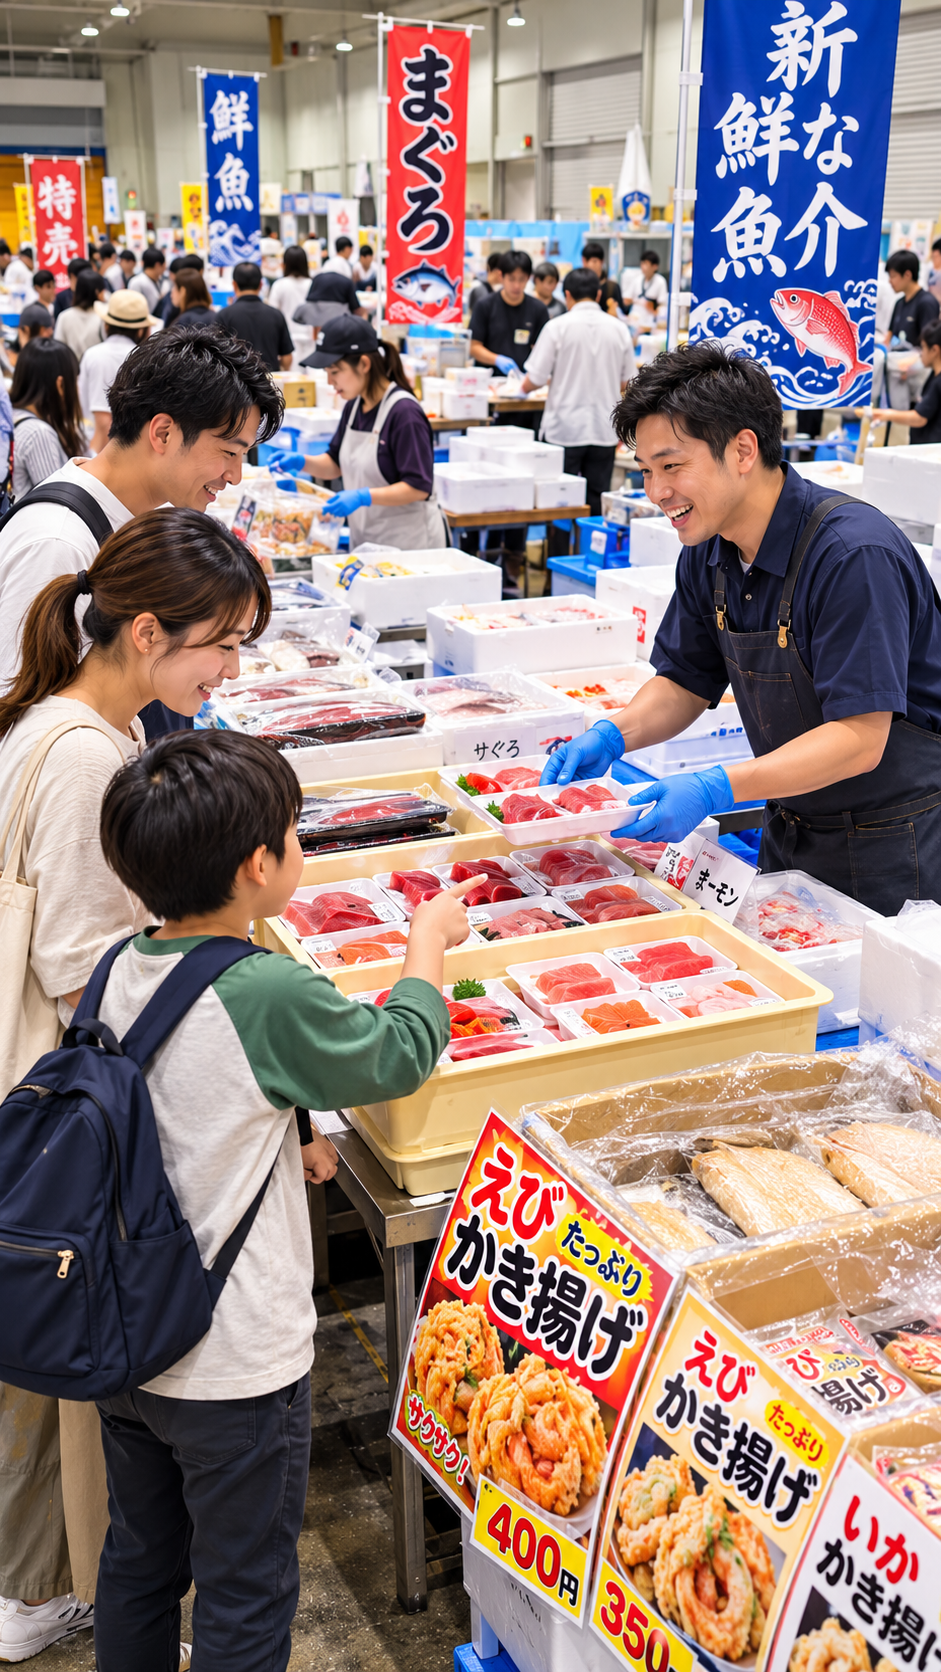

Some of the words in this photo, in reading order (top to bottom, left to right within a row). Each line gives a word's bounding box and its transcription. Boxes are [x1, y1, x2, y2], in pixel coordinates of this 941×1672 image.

[209, 90, 254, 213] 鮮魚
[399, 46, 456, 253] まぐろ
[710, 91, 800, 283] 鮮魚
[766, 0, 869, 278] 新な介
[37, 173, 79, 267] 特売
[470, 1146, 565, 1241] えび
[446, 1213, 645, 1375] かき揚げ
[684, 1329, 756, 1403] えび
[655, 1372, 818, 1523] かき揚げ
[486, 1502, 581, 1607] 400円
[843, 1494, 920, 1585] いか
[600, 1580, 677, 1672] 350
